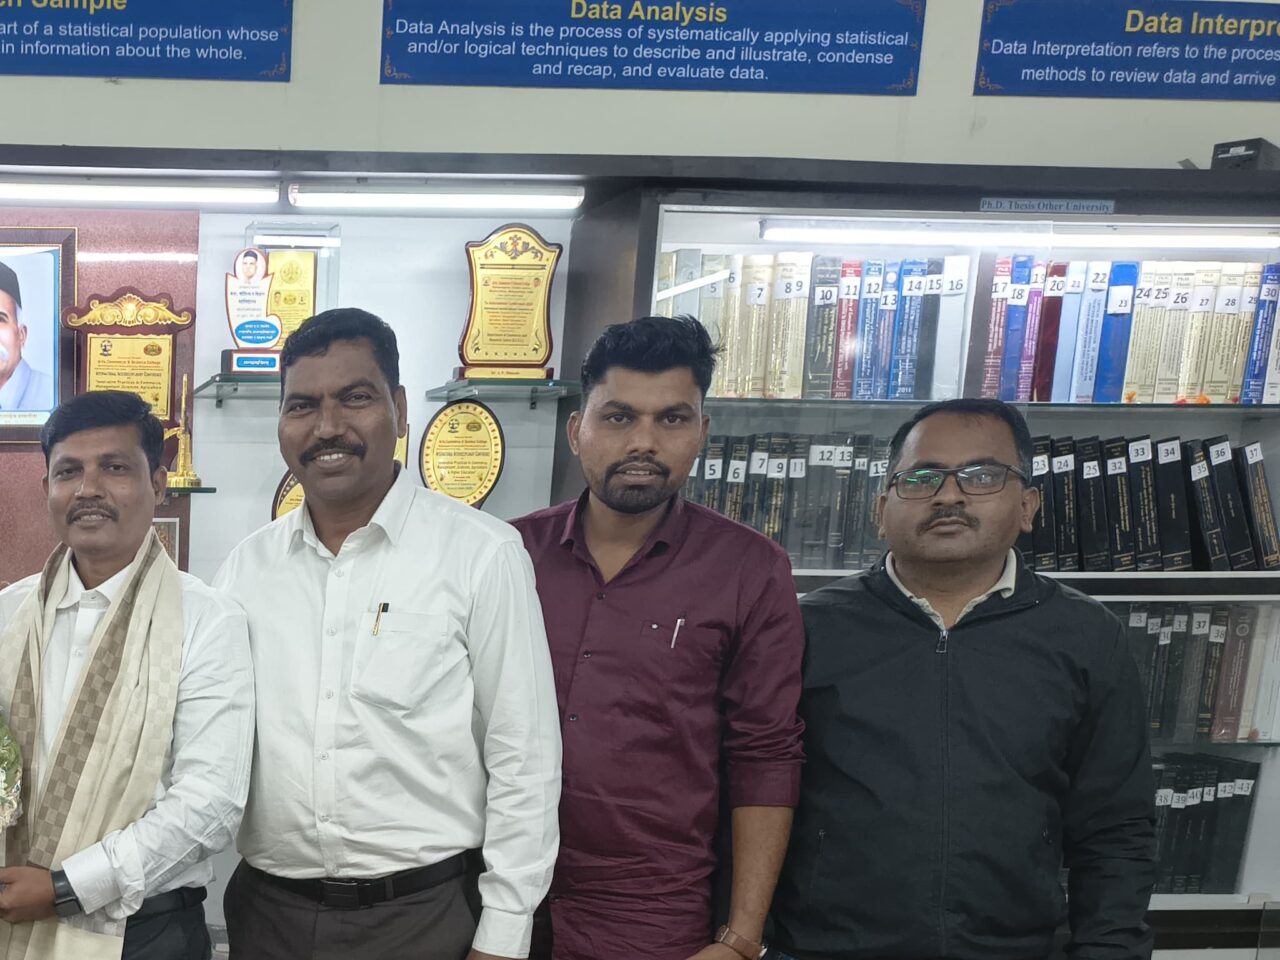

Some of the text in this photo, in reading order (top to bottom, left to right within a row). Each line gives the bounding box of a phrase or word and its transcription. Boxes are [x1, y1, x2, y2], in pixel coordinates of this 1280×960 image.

[571, 0, 726, 26] Data Analysis
[1125, 10, 1182, 33] Data
[23, 21, 39, 35] of
[44, 25, 53, 35] a
[59, 23, 132, 37] statistical
[139, 25, 221, 41] population
[227, 27, 278, 41] whose
[396, 19, 908, 47] Data Analysis is the process of systematically applying statistical
[21, 41, 109, 56] information
[116, 43, 160, 57] about
[166, 44, 190, 58] the
[196, 46, 246, 59] whole.
[408, 40, 893, 64] and/or logical techniques to describe and illustrate, condense
[992, 39, 1027, 54] Data
[1033, 40, 1132, 59] Interpretation
[1137, 43, 1179, 58] refers
[1185, 45, 1199, 58] to
[1204, 45, 1227, 59] the
[533, 61, 768, 79] and recap, and evaluate data.
[1022, 66, 1276, 85] methods to review data and arrive
[982, 200, 1110, 212] Ph.D. Thesis Other University
[1092, 272, 1108, 284] 22
[784, 282, 792, 294] 8
[845, 285, 858, 296] 11
[866, 283, 880, 294] 12
[908, 280, 923, 291] 14
[928, 279, 942, 290] 15
[948, 280, 964, 292] 16
[992, 282, 1008, 293] 17
[1050, 281, 1065, 292] 20
[756, 288, 764, 299] 7
[820, 290, 832, 301] 10
[1011, 288, 1025, 300] 18
[1136, 288, 1151, 299] 24
[1154, 288, 1169, 300] 25
[1173, 292, 1189, 304] 26
[1264, 288, 1277, 298] 30
[882, 294, 897, 306] 13
[1118, 298, 1128, 308] 23
[1200, 298, 1210, 306] 27
[1225, 298, 1236, 306] 28
[818, 450, 833, 462] 12
[840, 451, 852, 462] 13
[1133, 446, 1146, 458] 33
[1164, 447, 1176, 458] 34
[1214, 447, 1226, 458] 36
[1248, 448, 1259, 459] 37
[758, 458, 766, 469] 7
[776, 462, 784, 474] 9
[872, 462, 888, 475] 15
[1034, 458, 1046, 470] 23
[1056, 458, 1070, 470] 24
[1111, 461, 1124, 471] 32
[1196, 462, 1207, 475] 35
[708, 464, 716, 476] 5
[732, 468, 740, 480] 6
[1086, 464, 1098, 476] 25
[1196, 620, 1207, 629] 37
